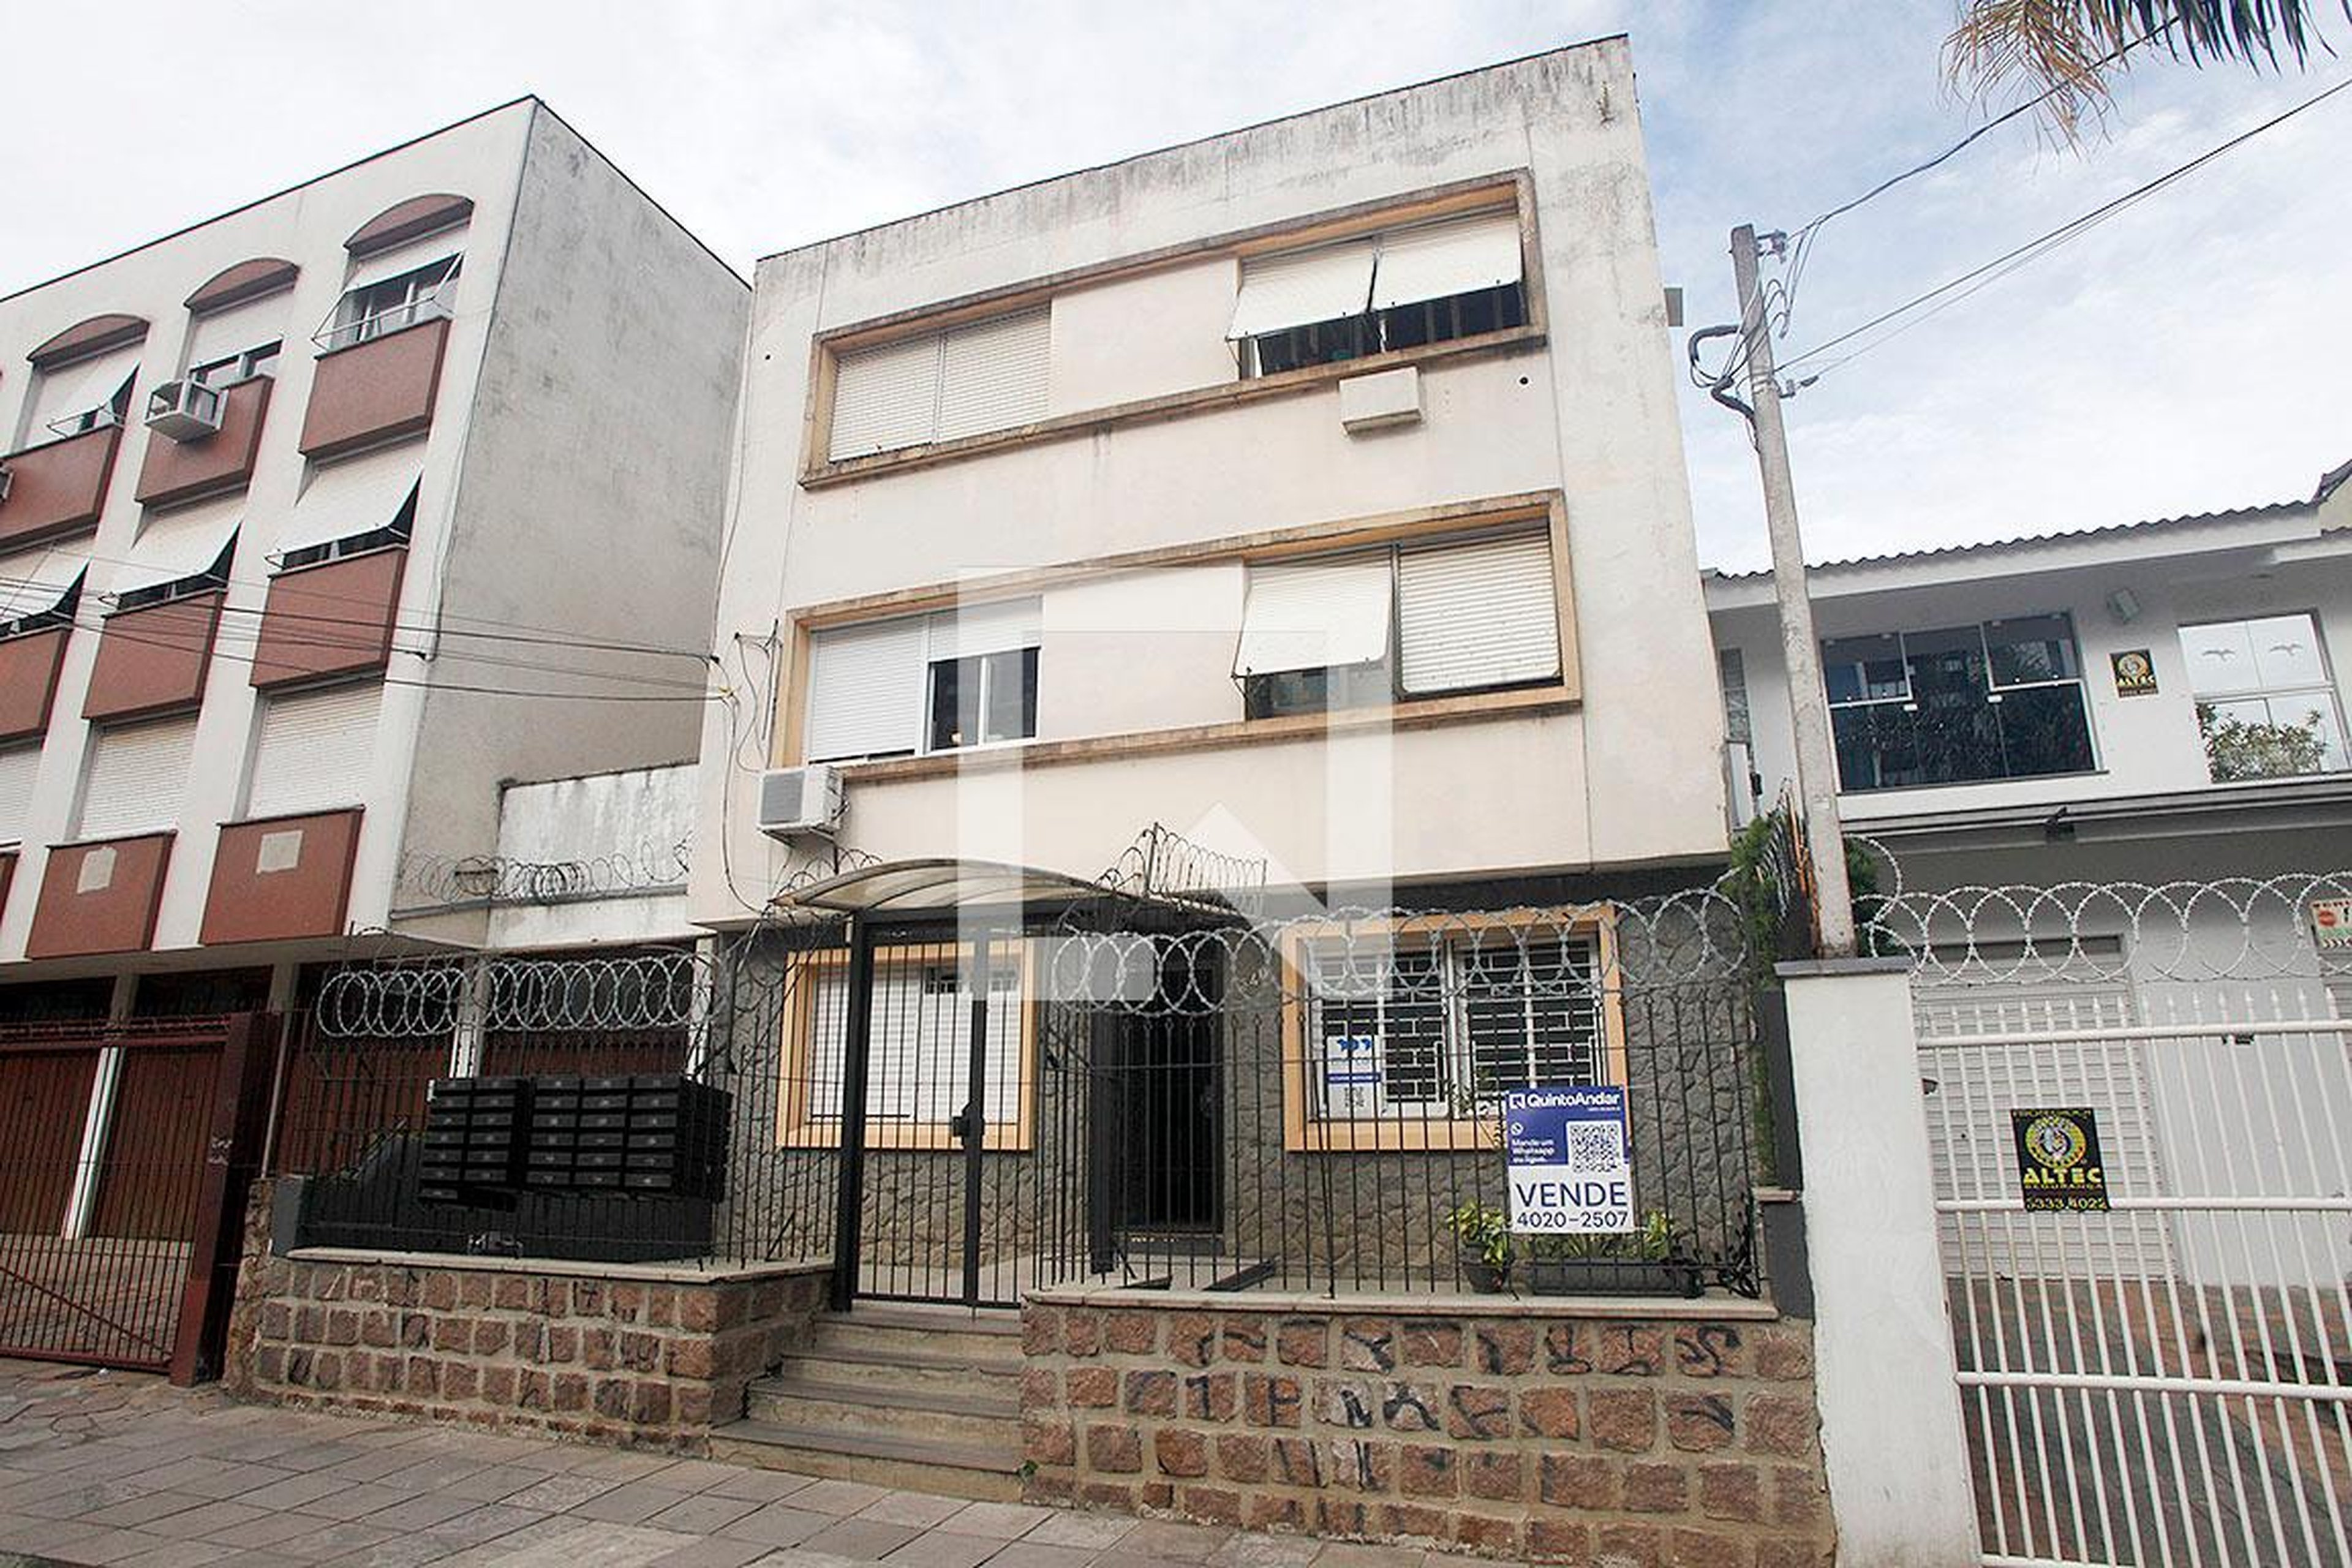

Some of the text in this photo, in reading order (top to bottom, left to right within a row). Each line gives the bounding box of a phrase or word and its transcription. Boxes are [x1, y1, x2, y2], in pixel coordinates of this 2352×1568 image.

[1527, 1092, 1621, 1108] QuintoAndar
[2023, 1167, 2101, 1184] ALTEC
[1515, 1182, 1629, 1207] VENDE
[1517, 1211, 1628, 1228] 4020-2507
